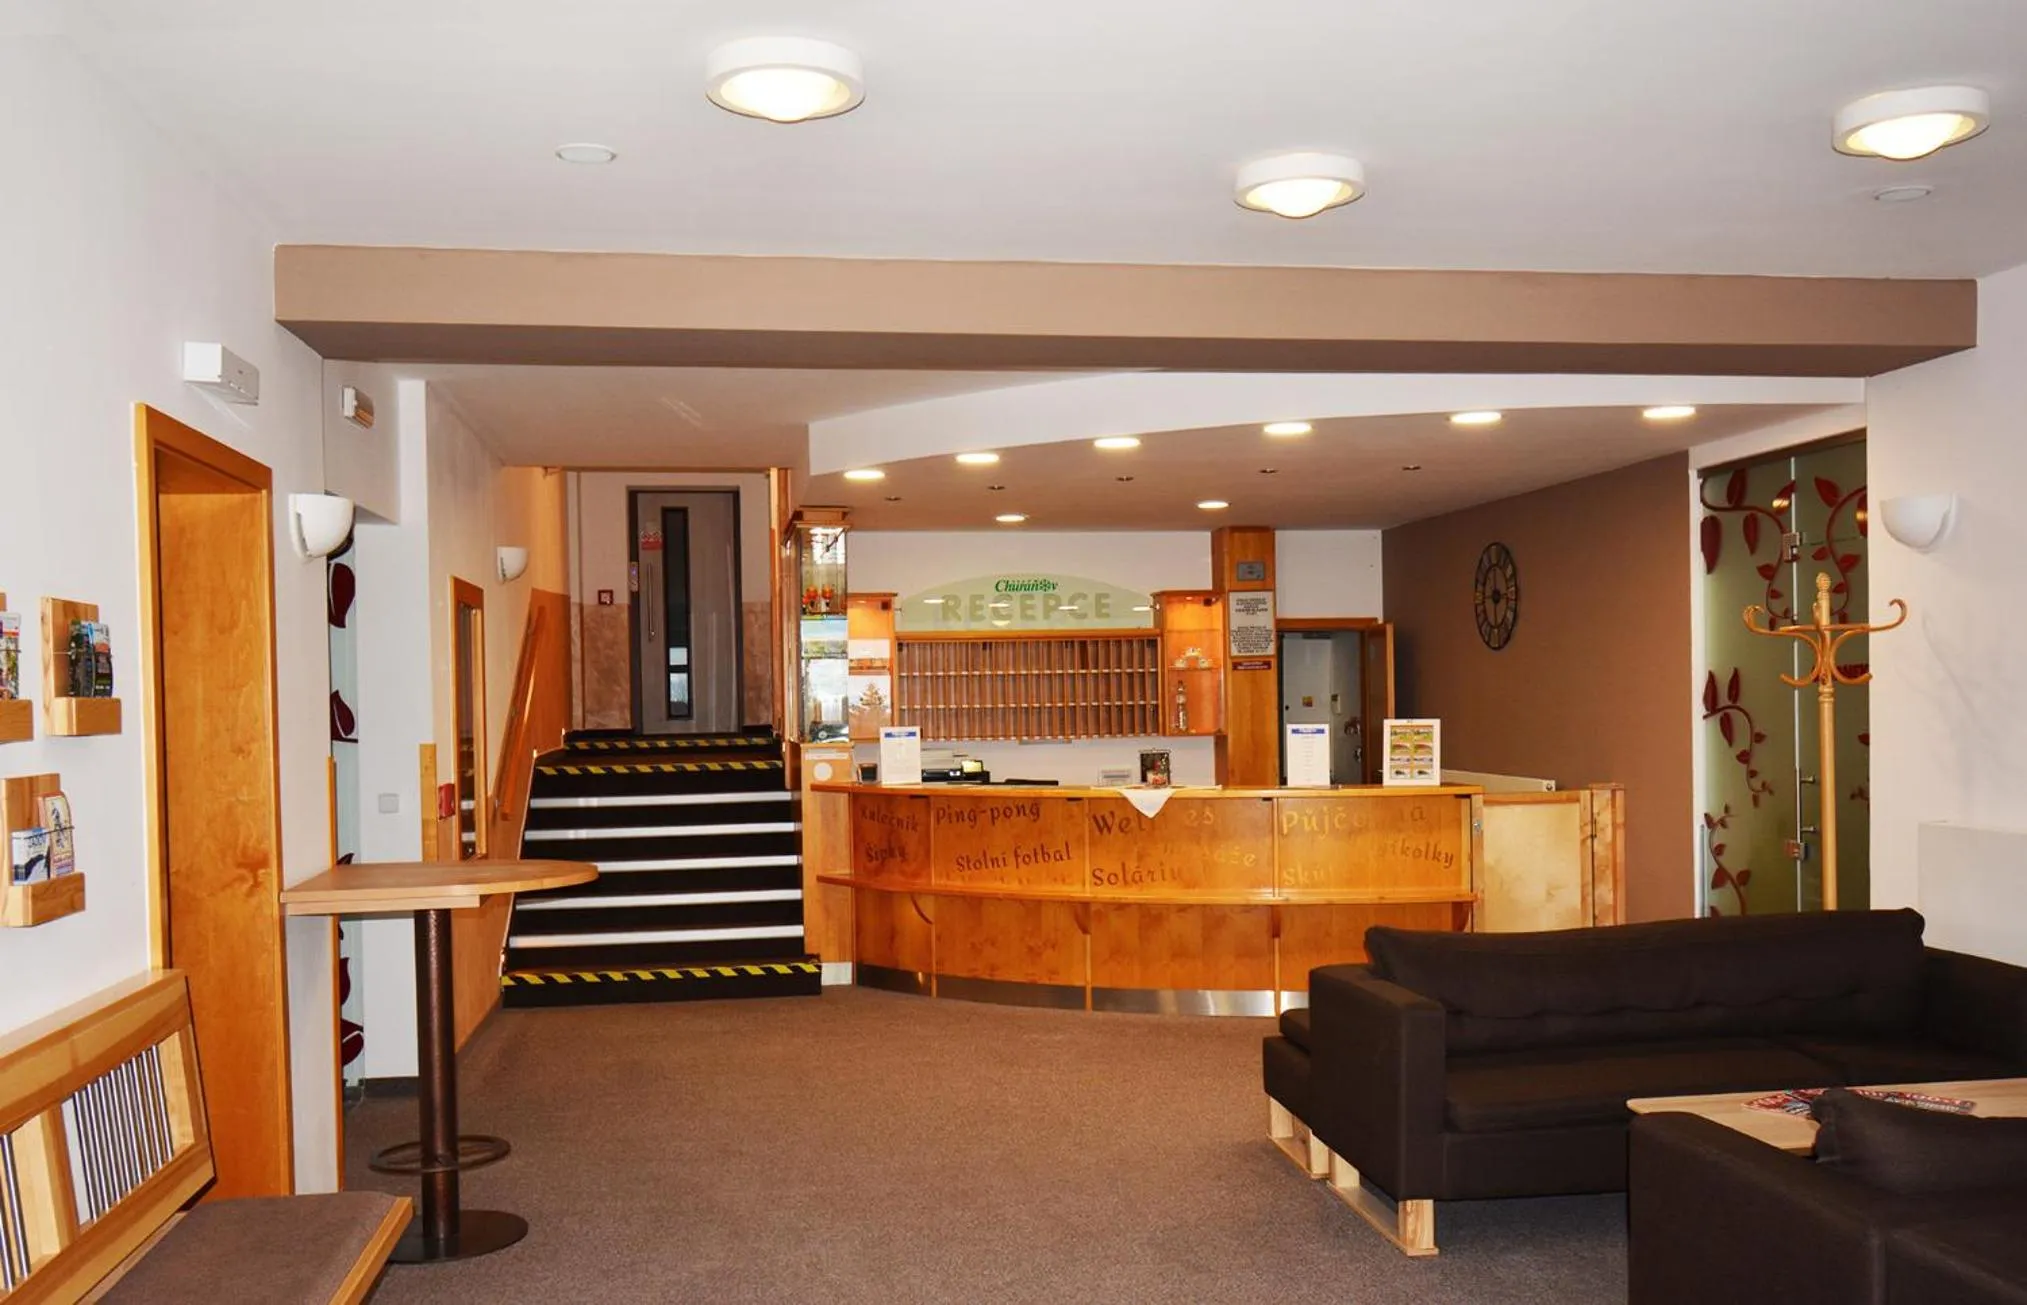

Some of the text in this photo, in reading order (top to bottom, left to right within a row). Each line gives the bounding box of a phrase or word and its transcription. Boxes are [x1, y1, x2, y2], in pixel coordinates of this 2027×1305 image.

[941, 592, 1111, 622] RECEPCE
[936, 801, 1041, 829] Ping-pong
[1013, 841, 1073, 869] fotbal
[1092, 861, 1186, 887] Soláriu
